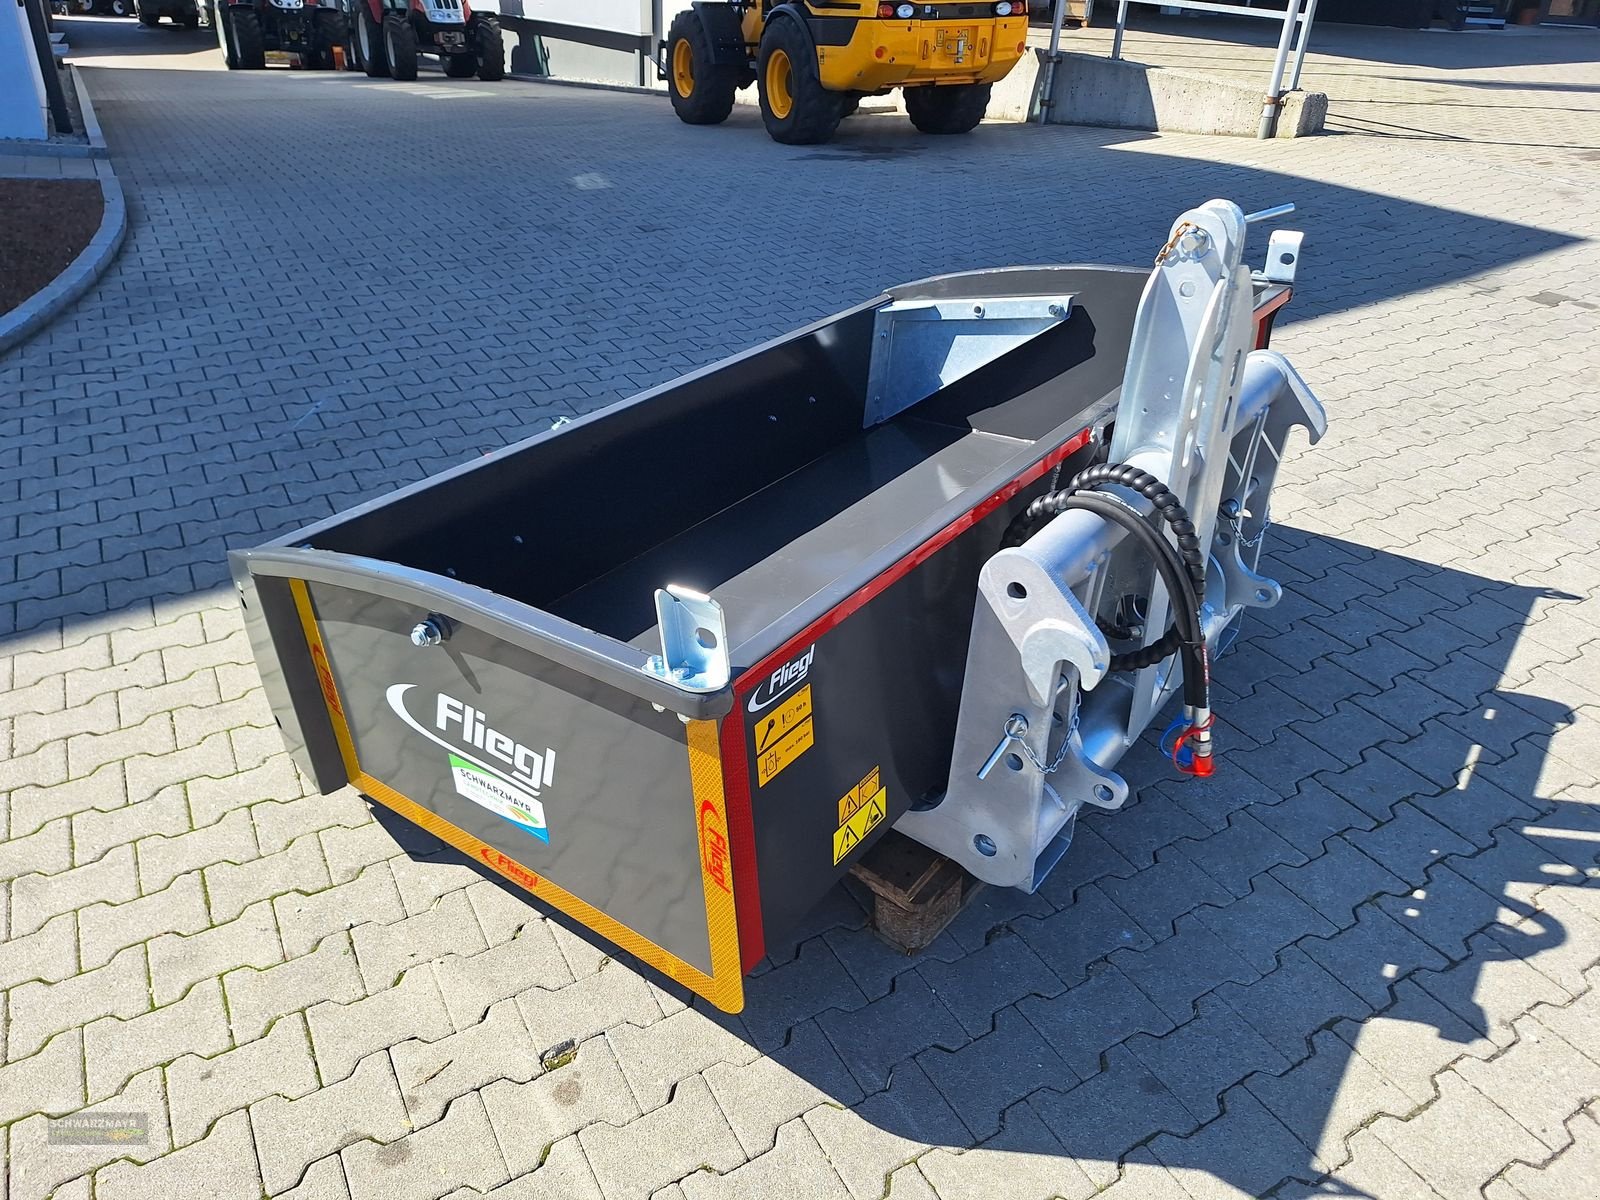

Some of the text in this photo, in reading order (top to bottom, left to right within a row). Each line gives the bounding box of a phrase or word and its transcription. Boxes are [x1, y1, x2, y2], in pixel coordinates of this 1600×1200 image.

[769, 643, 815, 695] Fliegl
[436, 692, 556, 788] Fliegl
[460, 768, 531, 813] SCHWARZMAYR
[498, 854, 538, 889] Fliegl
[708, 827, 732, 894] Fliegl
